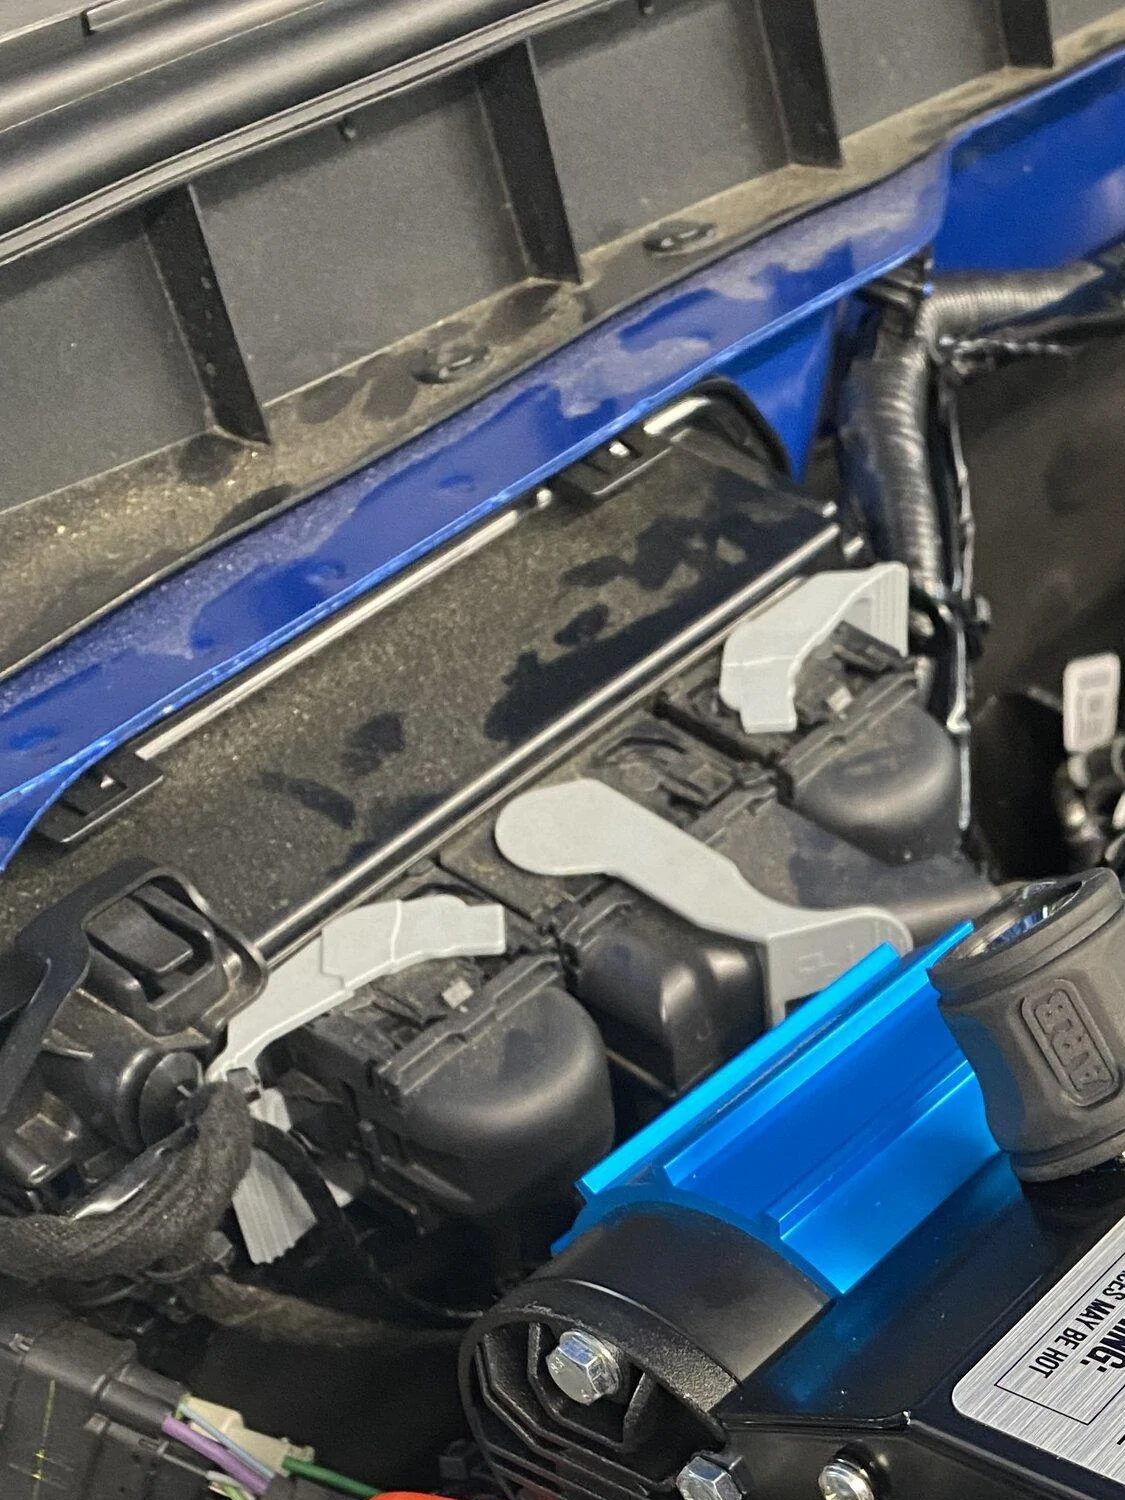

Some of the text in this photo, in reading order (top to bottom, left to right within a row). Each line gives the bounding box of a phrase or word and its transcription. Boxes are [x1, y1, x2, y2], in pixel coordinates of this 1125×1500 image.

[1033, 988, 1115, 1093] ARB
[1076, 1298, 1116, 1331] MAY
[1054, 1326, 1088, 1351] BE
[1028, 1347, 1069, 1379] HOT
